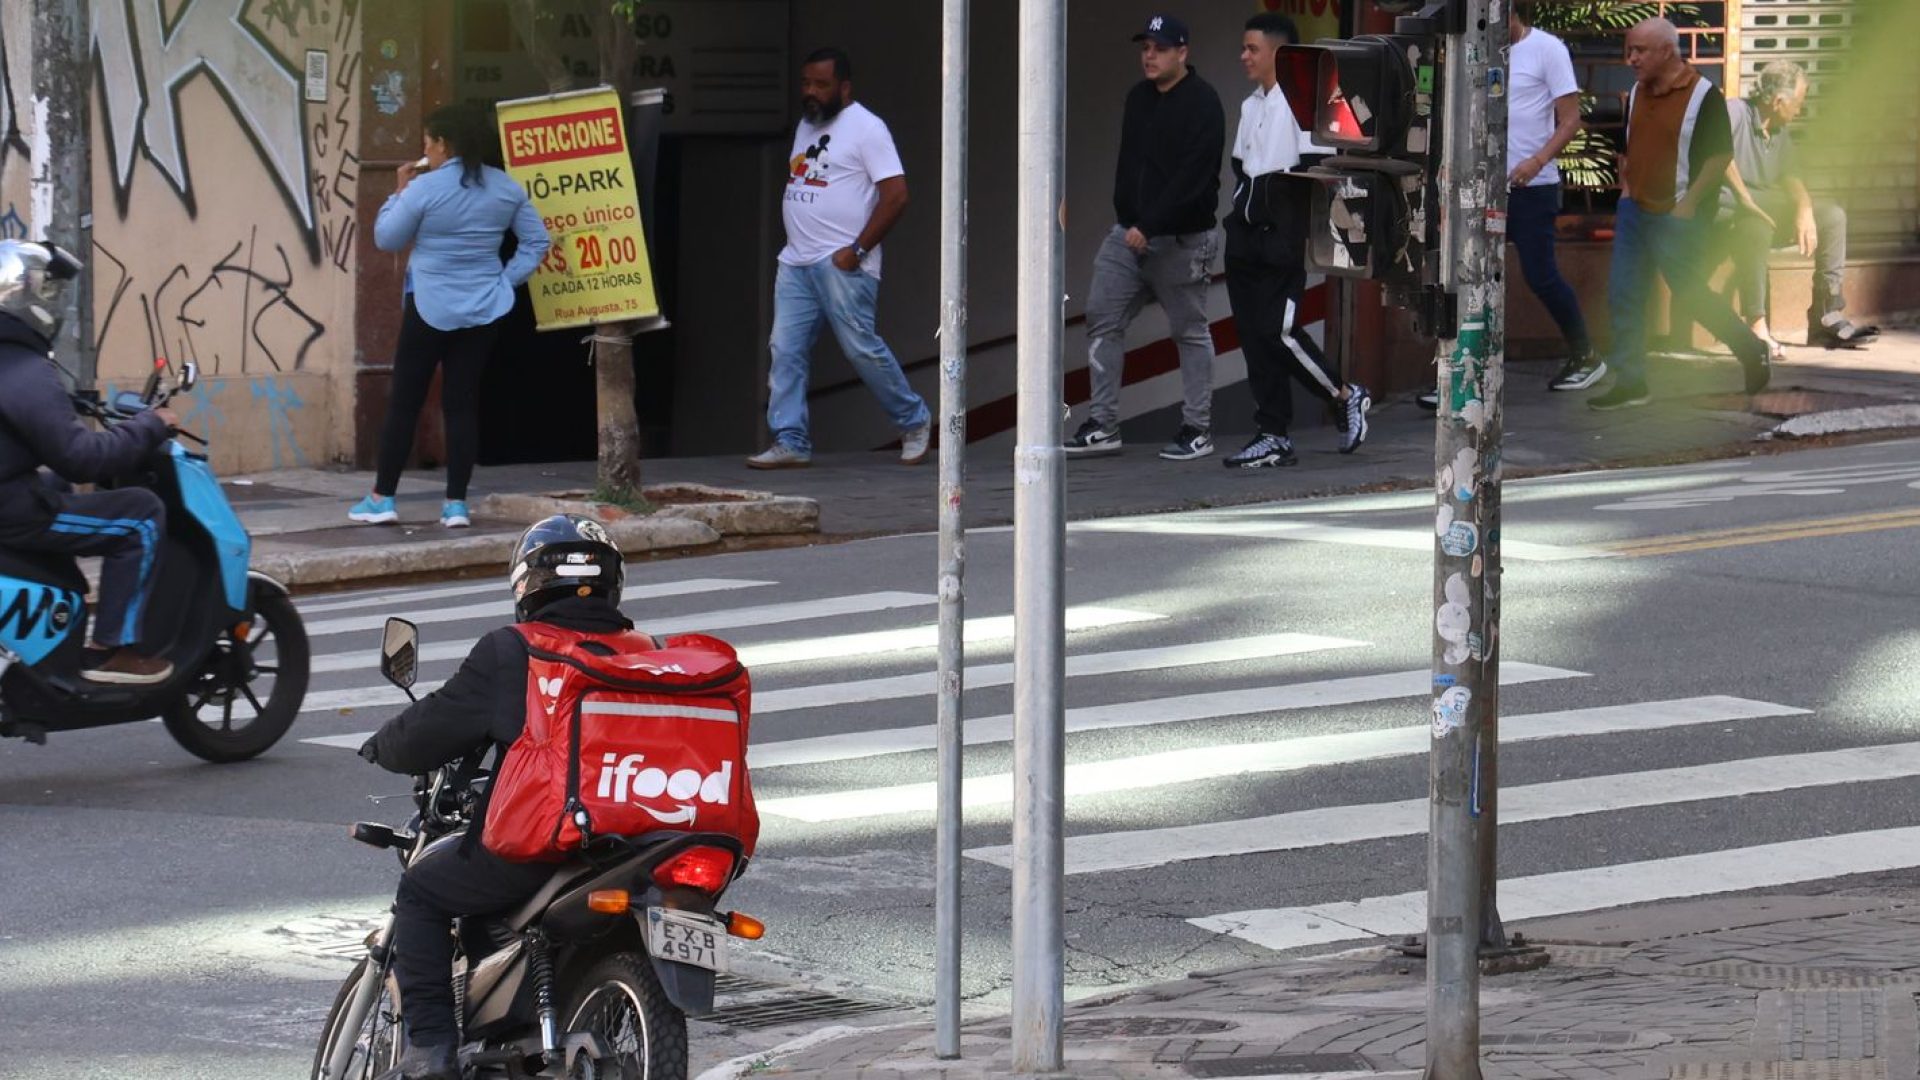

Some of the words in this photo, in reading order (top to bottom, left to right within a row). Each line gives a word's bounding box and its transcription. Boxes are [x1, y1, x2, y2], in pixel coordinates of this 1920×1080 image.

[561, 13, 673, 38] AVSO
[510, 117, 617, 158] ESTACIONE
[543, 213, 578, 233] eço
[583, 204, 635, 225] único
[576, 235, 637, 271] 20,00
[542, 285, 552, 297] A
[552, 281, 584, 295] CADA
[587, 278, 600, 290] 12
[602, 273, 642, 288] HORAS
[555, 308, 575, 319] Rua
[577, 303, 623, 317] Augusta,
[625, 299, 638, 310] 75
[597, 752, 732, 804] ifood
[663, 921, 715, 949] EXB
[663, 941, 715, 966] 4971
